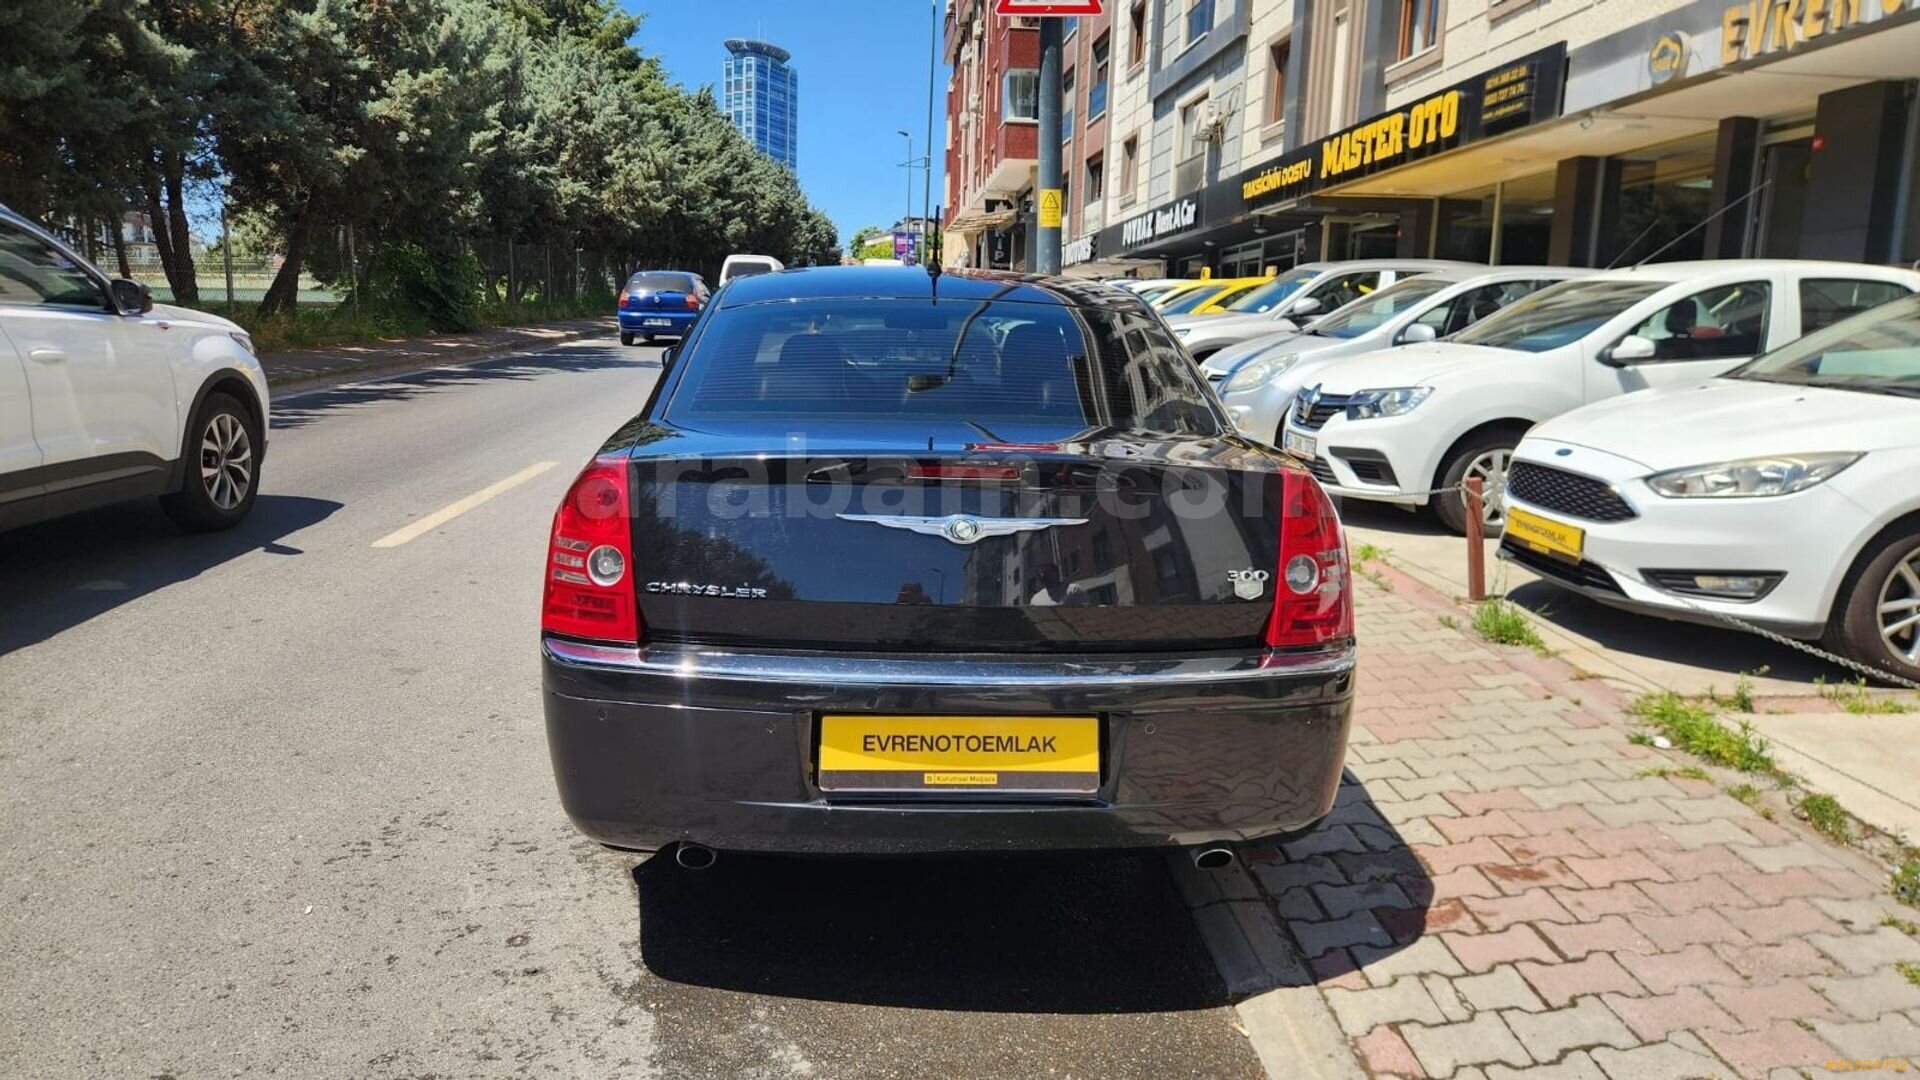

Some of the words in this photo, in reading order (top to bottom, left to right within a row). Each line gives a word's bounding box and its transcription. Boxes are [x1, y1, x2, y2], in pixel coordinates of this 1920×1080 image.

[1321, 112, 1404, 179] MASTER
[1408, 90, 1459, 149] OTO
[1227, 569, 1269, 581] 300
[645, 581, 767, 598] CHRYSLER
[862, 734, 1057, 753] EVRENOTOEMLAK
